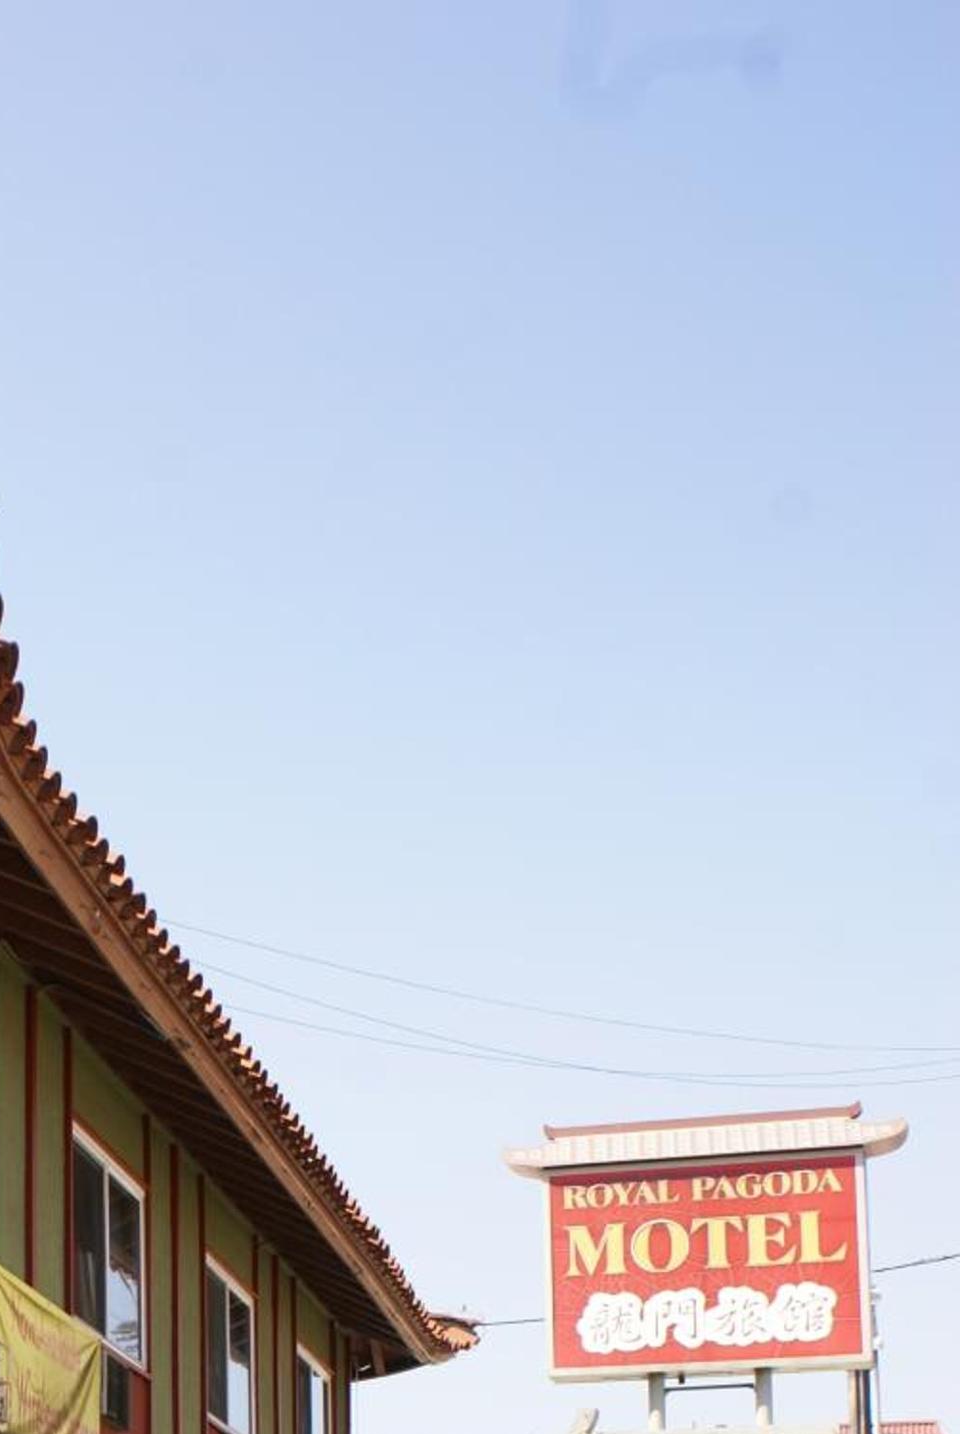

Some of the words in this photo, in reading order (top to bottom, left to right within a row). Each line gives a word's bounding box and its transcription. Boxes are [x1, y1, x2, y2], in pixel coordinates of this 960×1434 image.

[563, 1179, 680, 1210] ROYAL
[692, 1168, 843, 1201] PAGODA
[564, 1210, 848, 1277] MOTEL
[585, 1288, 832, 1349] 龍門旅館
